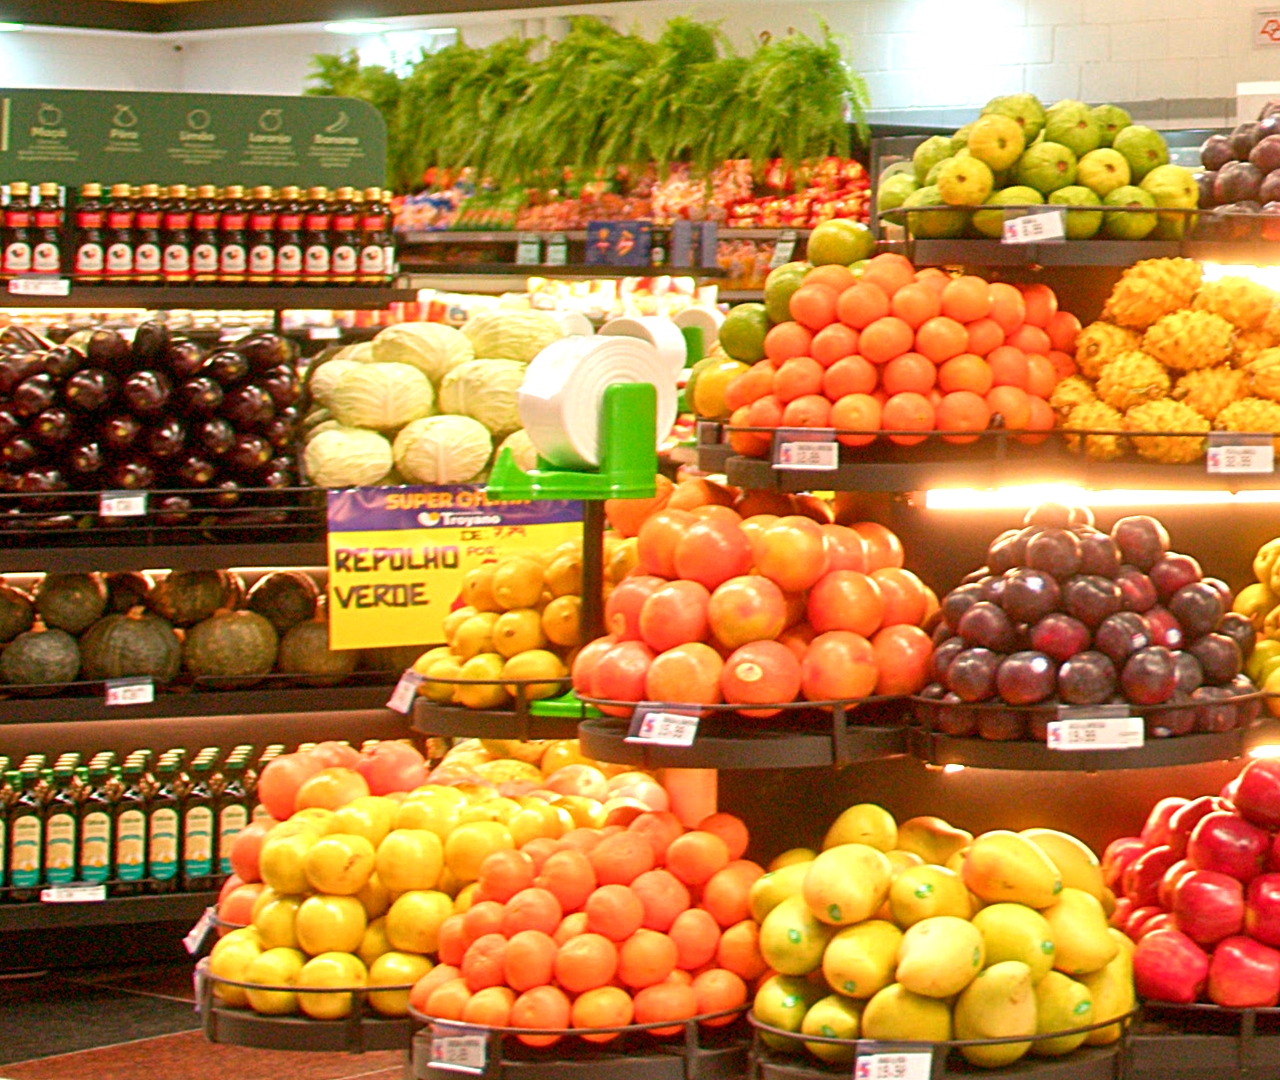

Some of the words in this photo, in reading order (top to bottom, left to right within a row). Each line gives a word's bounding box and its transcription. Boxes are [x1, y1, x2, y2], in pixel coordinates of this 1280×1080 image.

[385, 492, 452, 510] SUPER
[440, 512, 502, 527] Troyano
[335, 546, 459, 572] REPOLHO
[334, 582, 429, 609] VERDE
